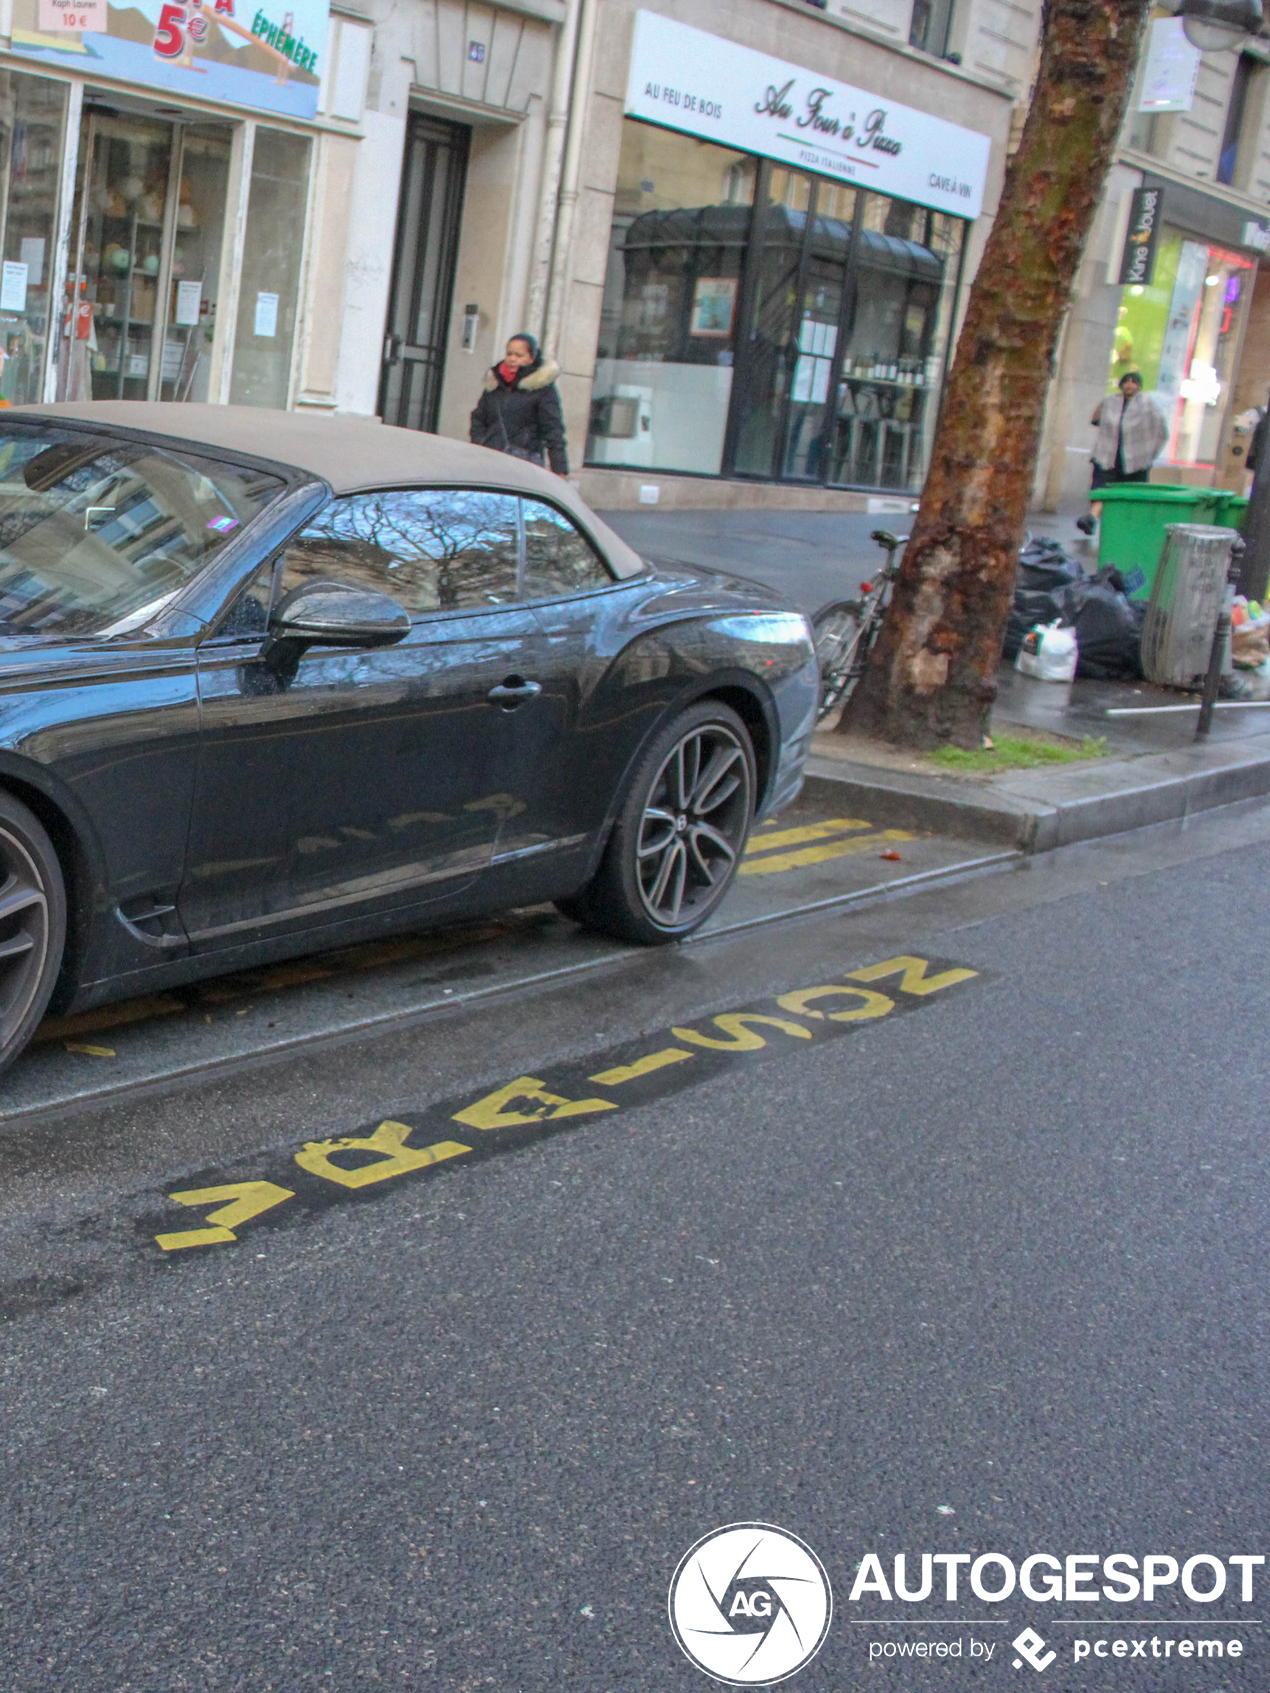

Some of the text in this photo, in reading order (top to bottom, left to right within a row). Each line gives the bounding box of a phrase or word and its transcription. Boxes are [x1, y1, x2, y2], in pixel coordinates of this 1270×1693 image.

[63, 13, 76, 26] 10
[644, 81, 722, 119] AU FEU DE BOIS
[755, 78, 793, 117] Au
[797, 87, 840, 135] Four
[856, 108, 903, 157] Pizza
